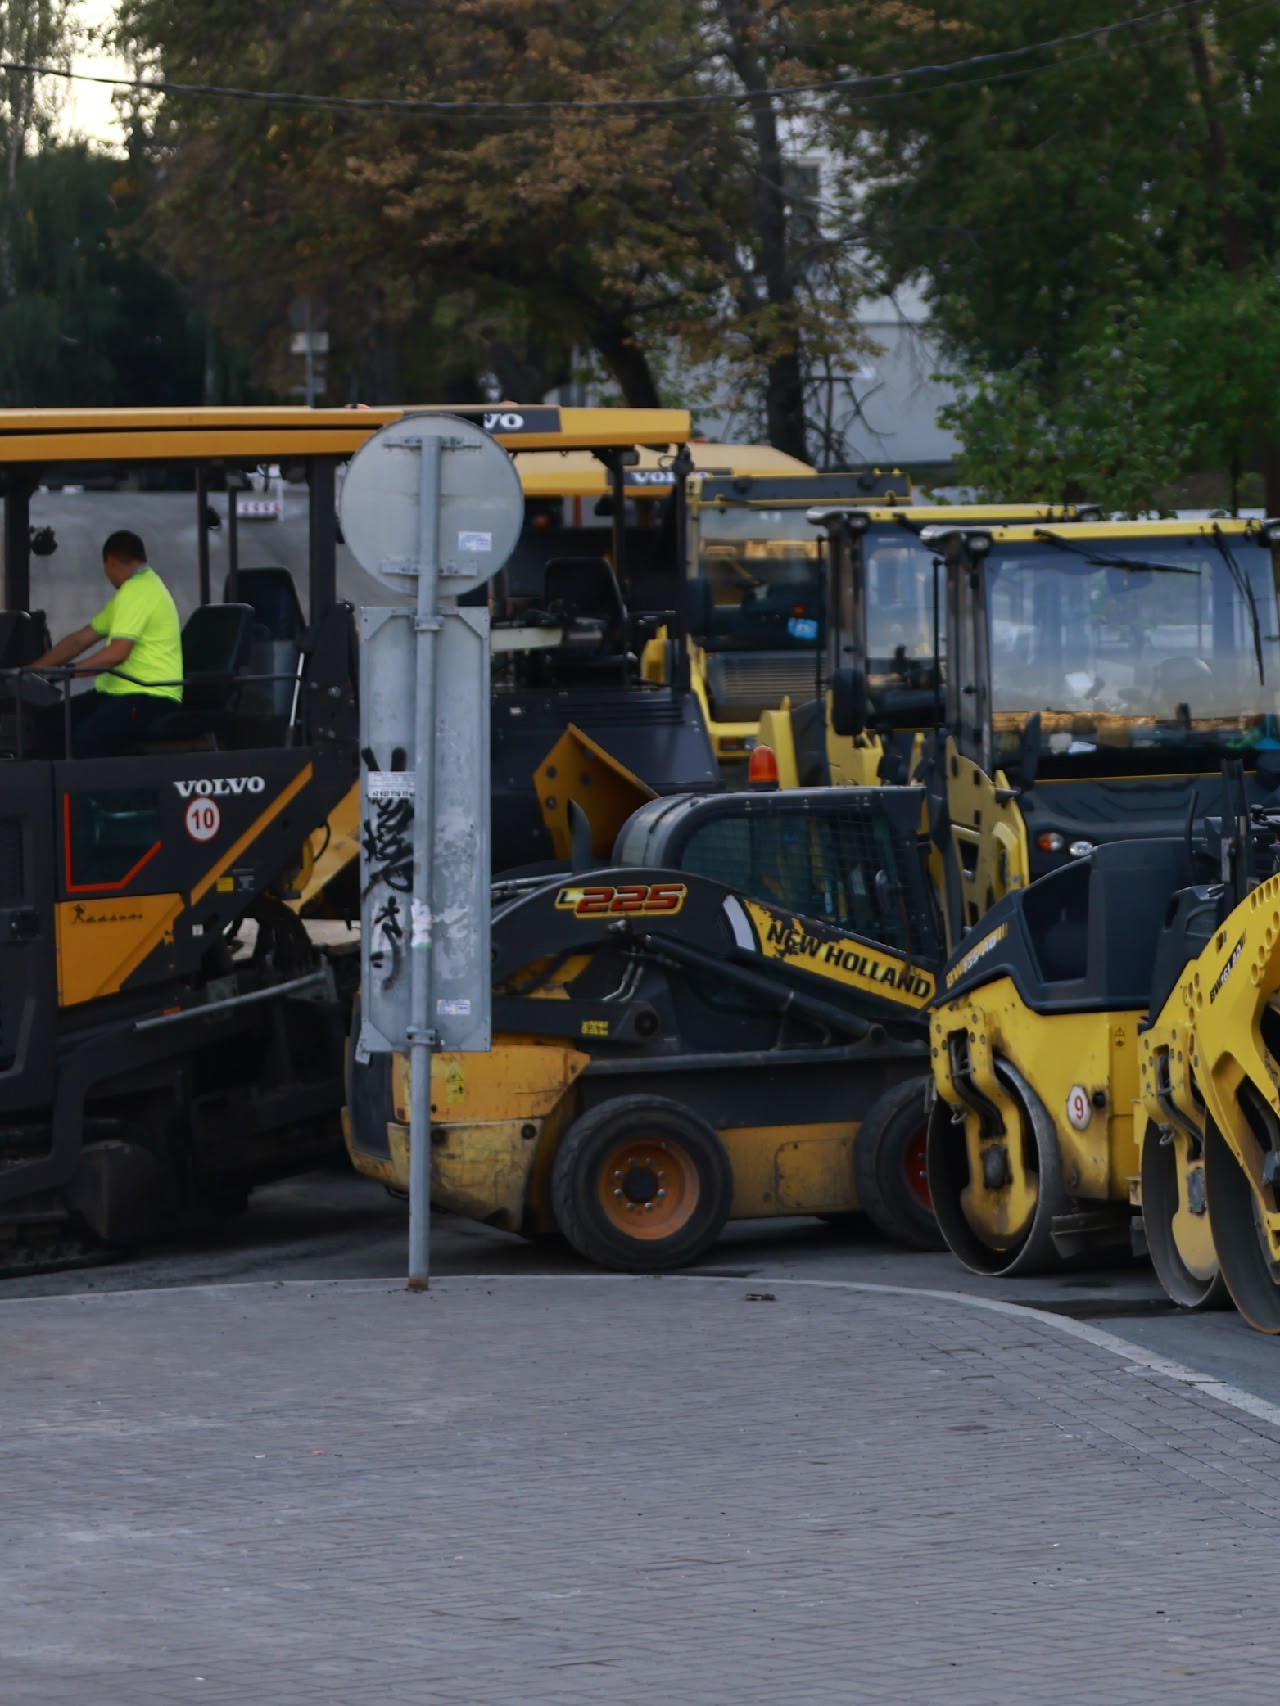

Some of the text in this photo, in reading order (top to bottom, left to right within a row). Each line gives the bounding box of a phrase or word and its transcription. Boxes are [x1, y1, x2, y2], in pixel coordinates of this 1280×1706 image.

[173, 776, 265, 798] VOLVO
[191, 807, 215, 830] 10
[766, 918, 931, 998] NEW HOLLAND
[1074, 1095, 1084, 1120] 9
